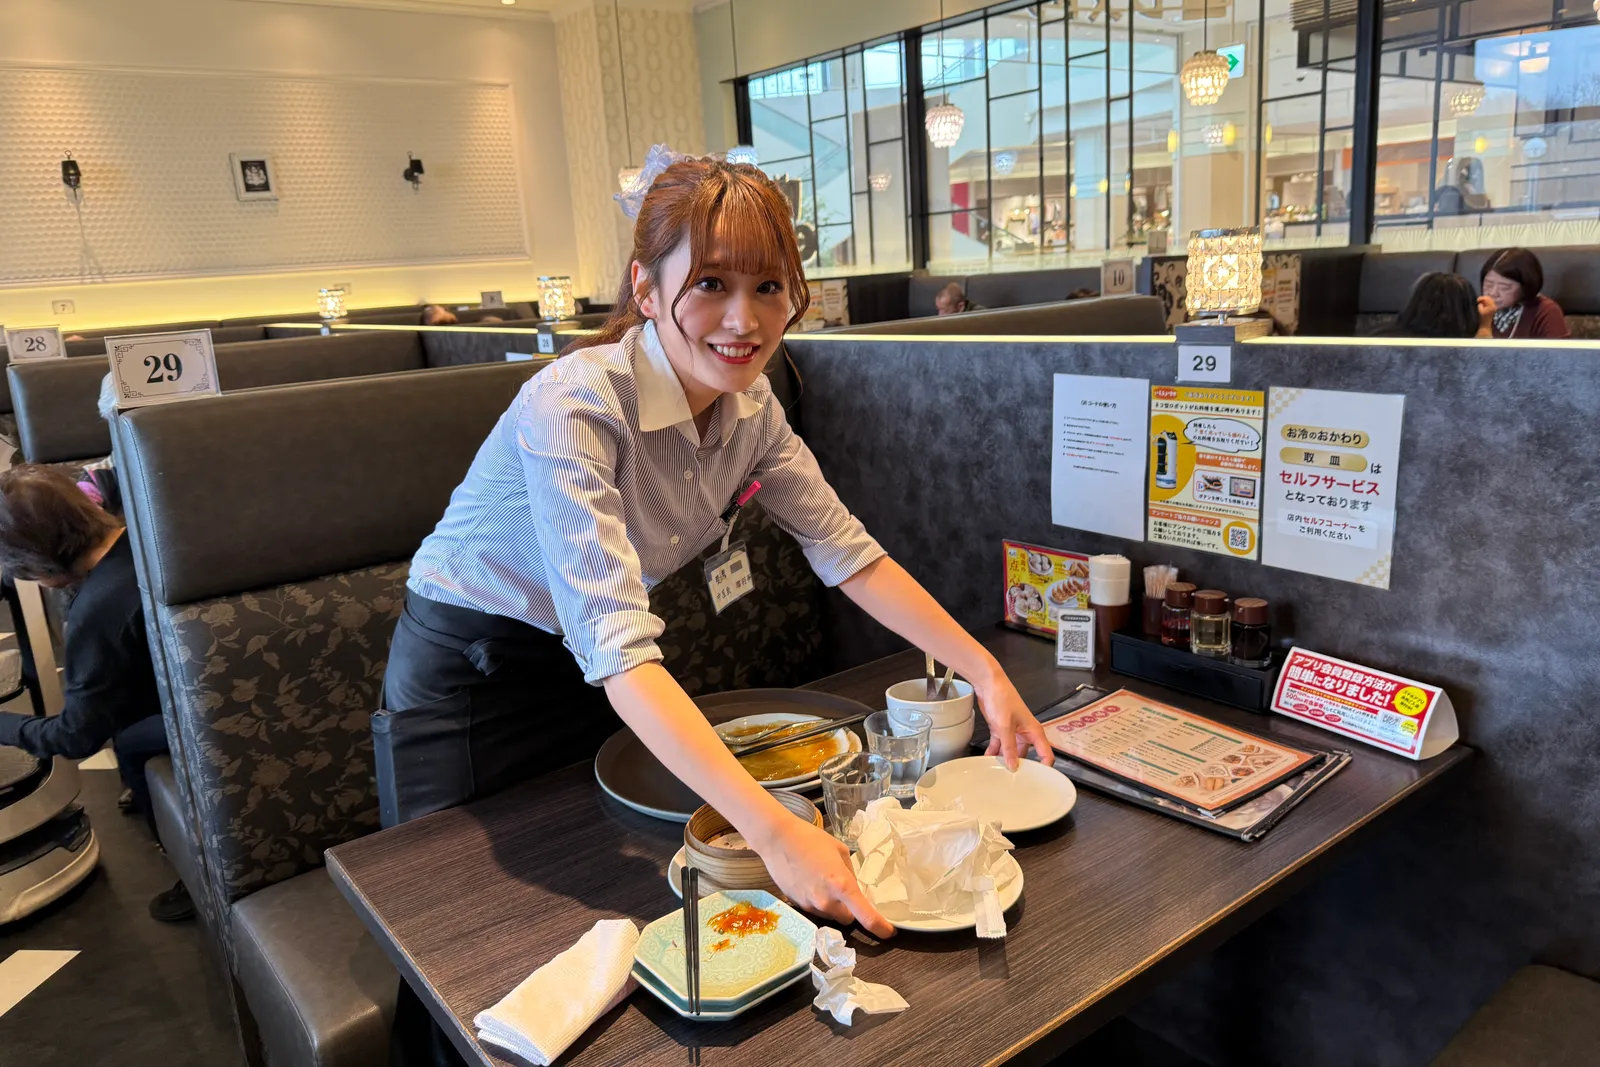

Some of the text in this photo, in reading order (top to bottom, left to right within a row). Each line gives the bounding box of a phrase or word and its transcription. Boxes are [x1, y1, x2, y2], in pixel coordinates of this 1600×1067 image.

[1112, 269, 1125, 286] 10
[24, 335, 47, 352] 28
[143, 353, 183, 384] 29
[1192, 355, 1217, 372] 29
[1286, 427, 1362, 445] お冷のおかわり
[1279, 470, 1381, 496] セルフサービス
[1285, 489, 1372, 512] となっております
[1287, 513, 1366, 533] 店内セルフコーナーを
[1299, 525, 1352, 541] ご利用ください
[1293, 654, 1398, 692] アプリ会員登録方法が
